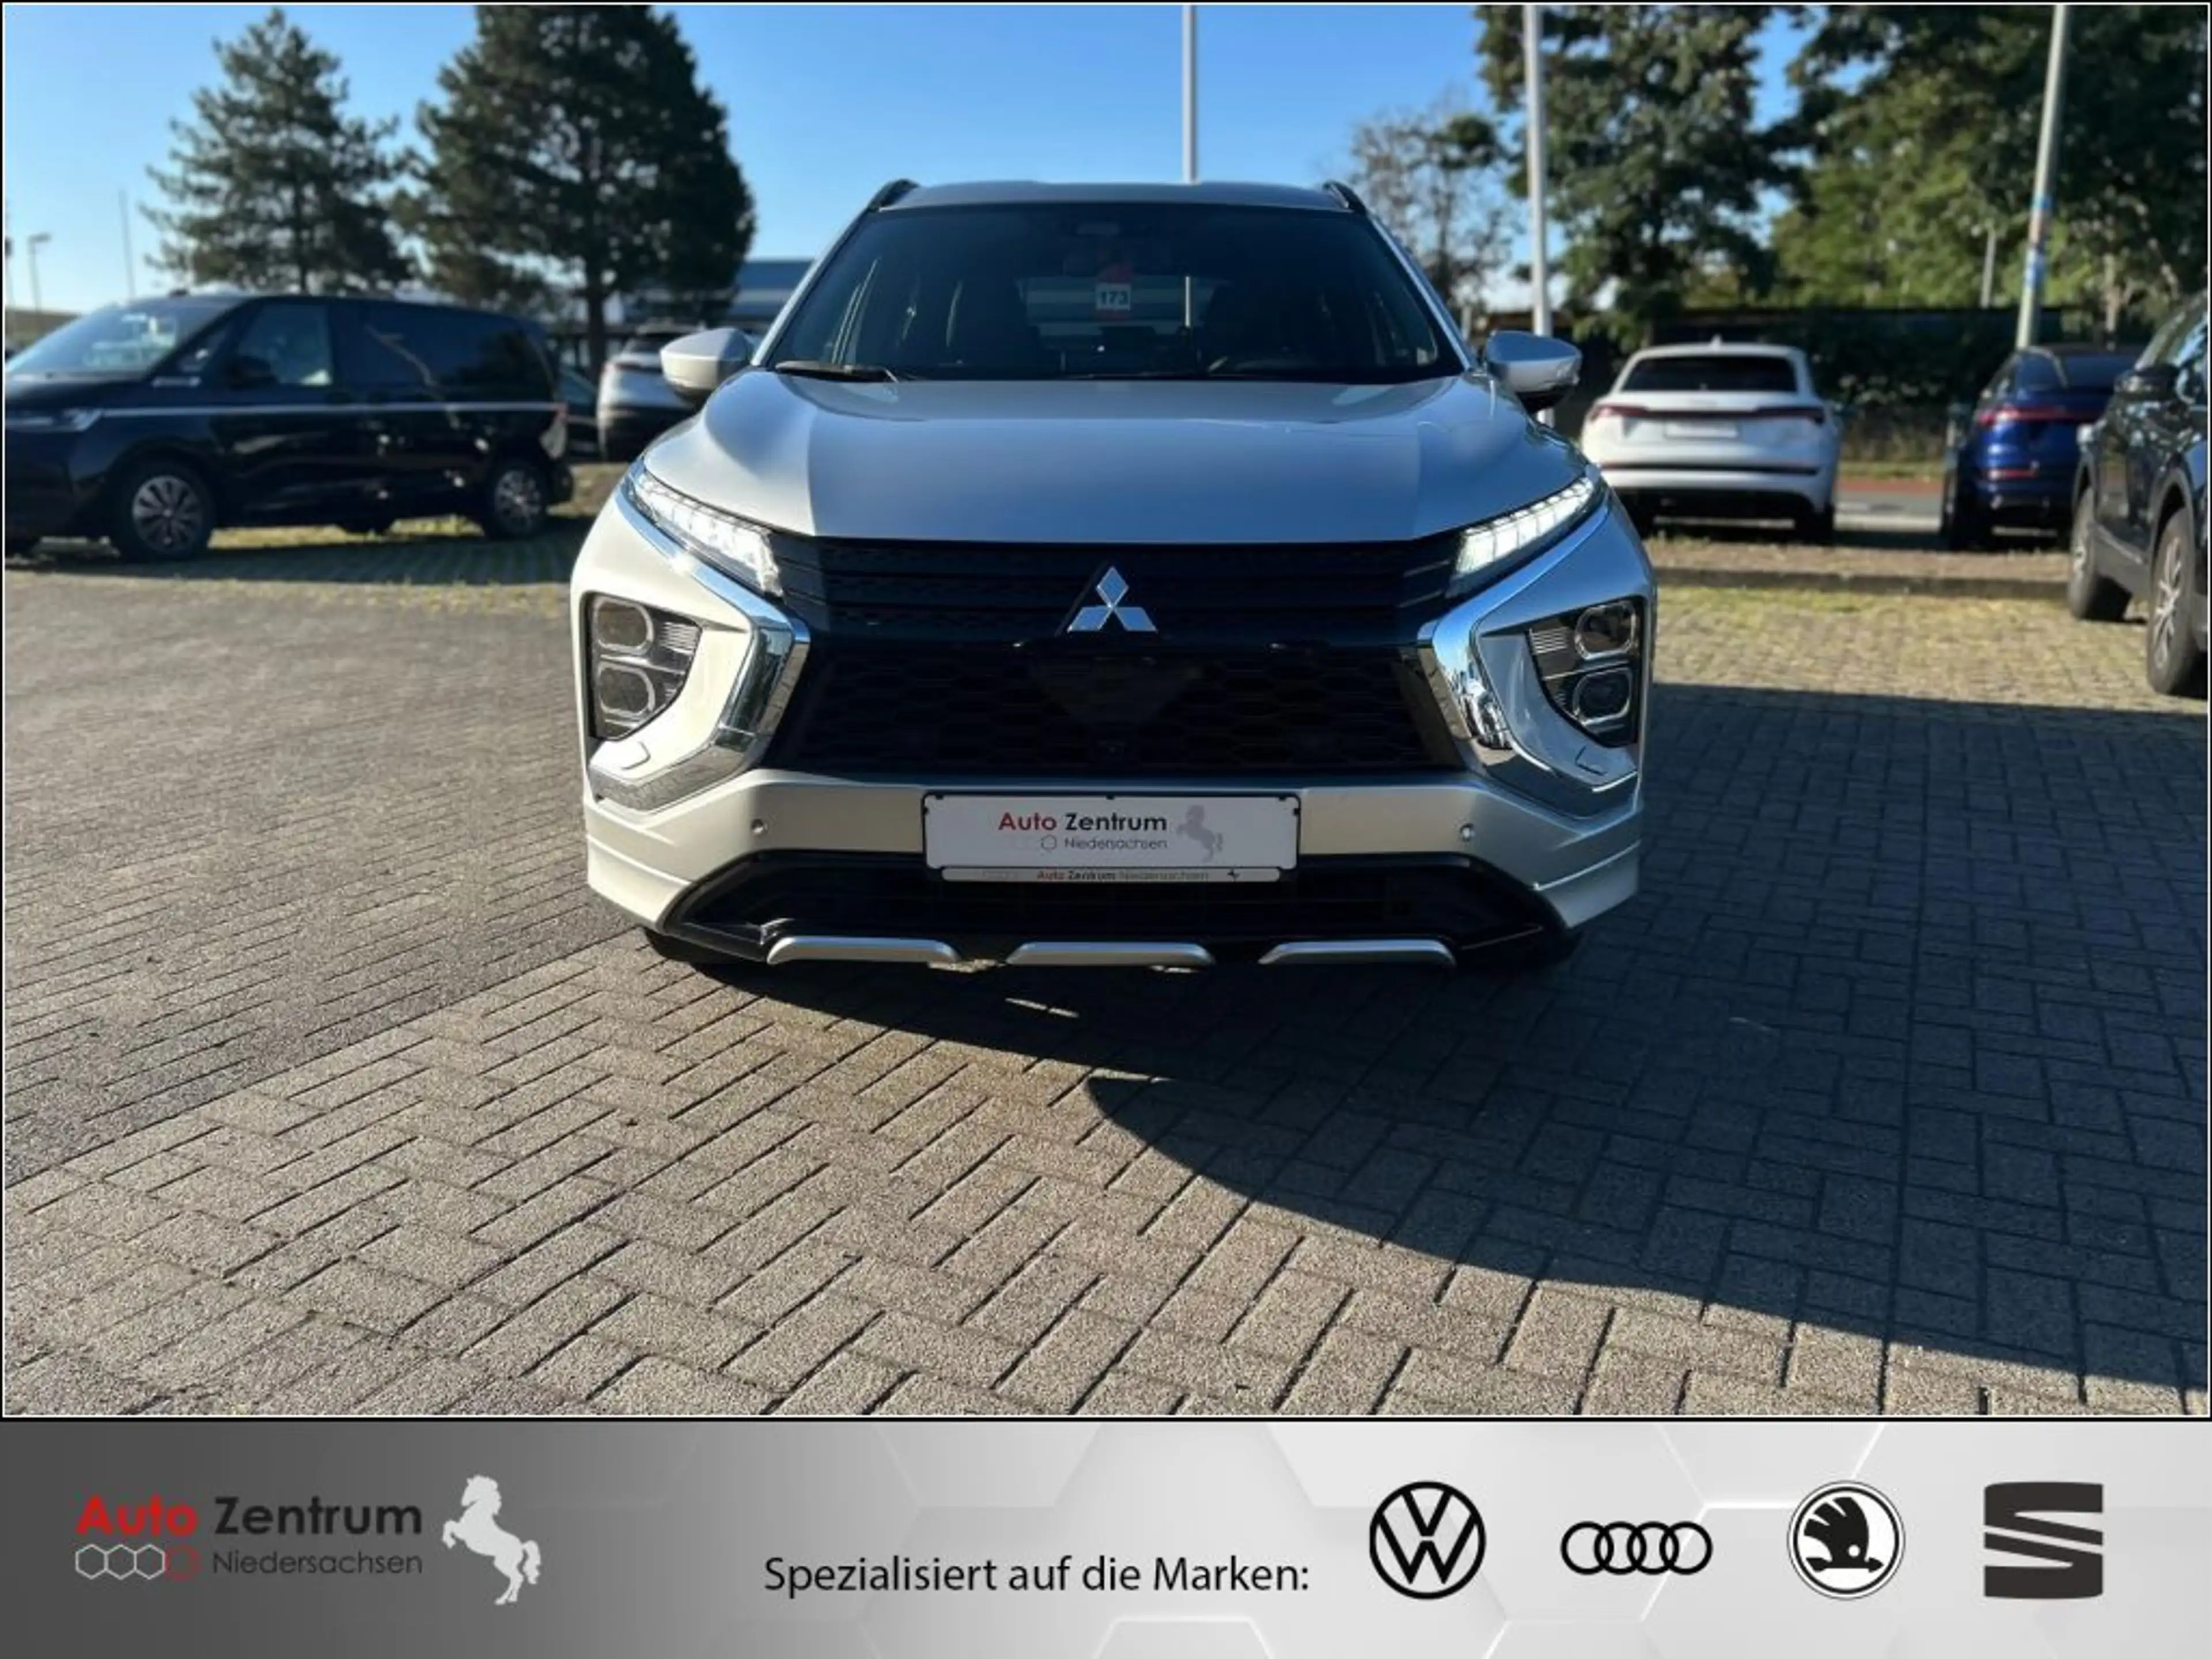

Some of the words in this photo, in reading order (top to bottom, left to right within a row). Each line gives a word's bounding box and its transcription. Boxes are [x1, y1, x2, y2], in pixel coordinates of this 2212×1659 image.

[998, 812, 1058, 831] Auto
[1065, 812, 1168, 831] Zentrum
[1064, 836, 1168, 850] Niedersachsen
[1037, 870, 1064, 880] Auto
[1068, 870, 1116, 880] Zentrum
